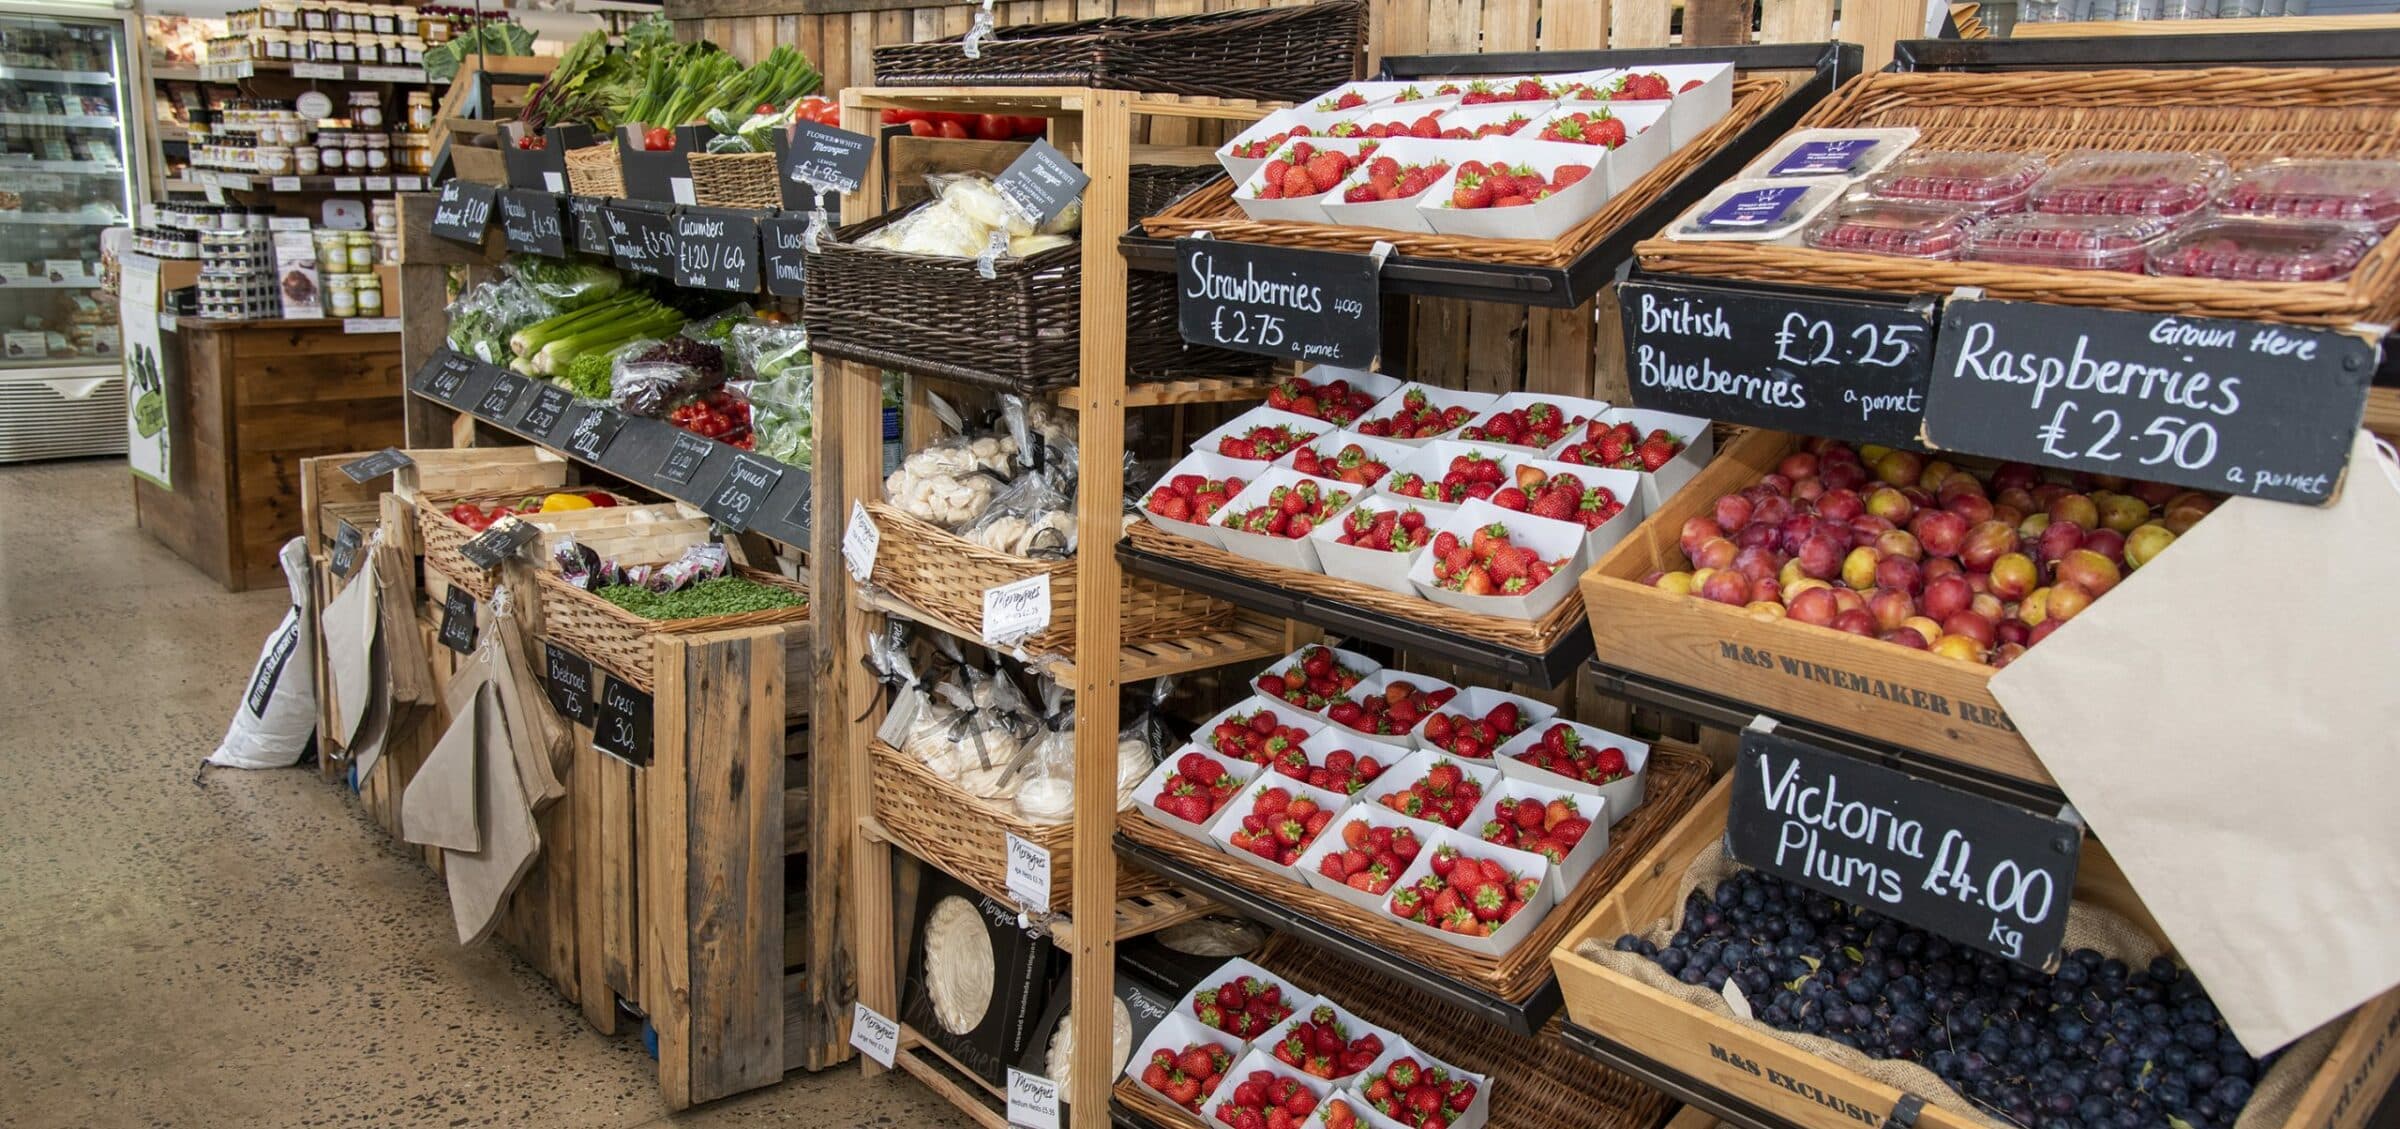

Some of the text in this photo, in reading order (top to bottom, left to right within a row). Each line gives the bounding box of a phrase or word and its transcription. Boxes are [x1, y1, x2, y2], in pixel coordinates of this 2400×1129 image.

[679, 216, 724, 237] Cucumbers
[777, 226, 801, 249] Loos
[771, 255, 806, 281] Tomat
[1187, 251, 1363, 319] Strawberries 400g
[1640, 294, 1732, 340] British
[1291, 341, 1301, 351] a
[2148, 317, 2318, 361] Grown Here
[1637, 344, 1807, 409] Blueberries
[1953, 322, 2242, 416] Raspberries
[1843, 388, 1858, 402] a
[2226, 465, 2331, 495] a punnet
[990, 586, 1041, 611] Meringues
[552, 659, 587, 692] Beetroot
[1718, 640, 2017, 732] M&S WINEMAKER RES
[563, 688, 582, 717] 75p
[607, 683, 635, 716] Cress
[612, 717, 635, 753] 30p
[1758, 754, 1924, 859] Victoria
[1008, 836, 1045, 871] Meringues
[1776, 820, 2054, 924] Plums £4.00
[1127, 987, 1167, 1019] Meringues
[859, 1007, 895, 1040] Meringues
[1708, 1042, 1762, 1077] M&S
[1012, 1071, 1054, 1104] Meringues
